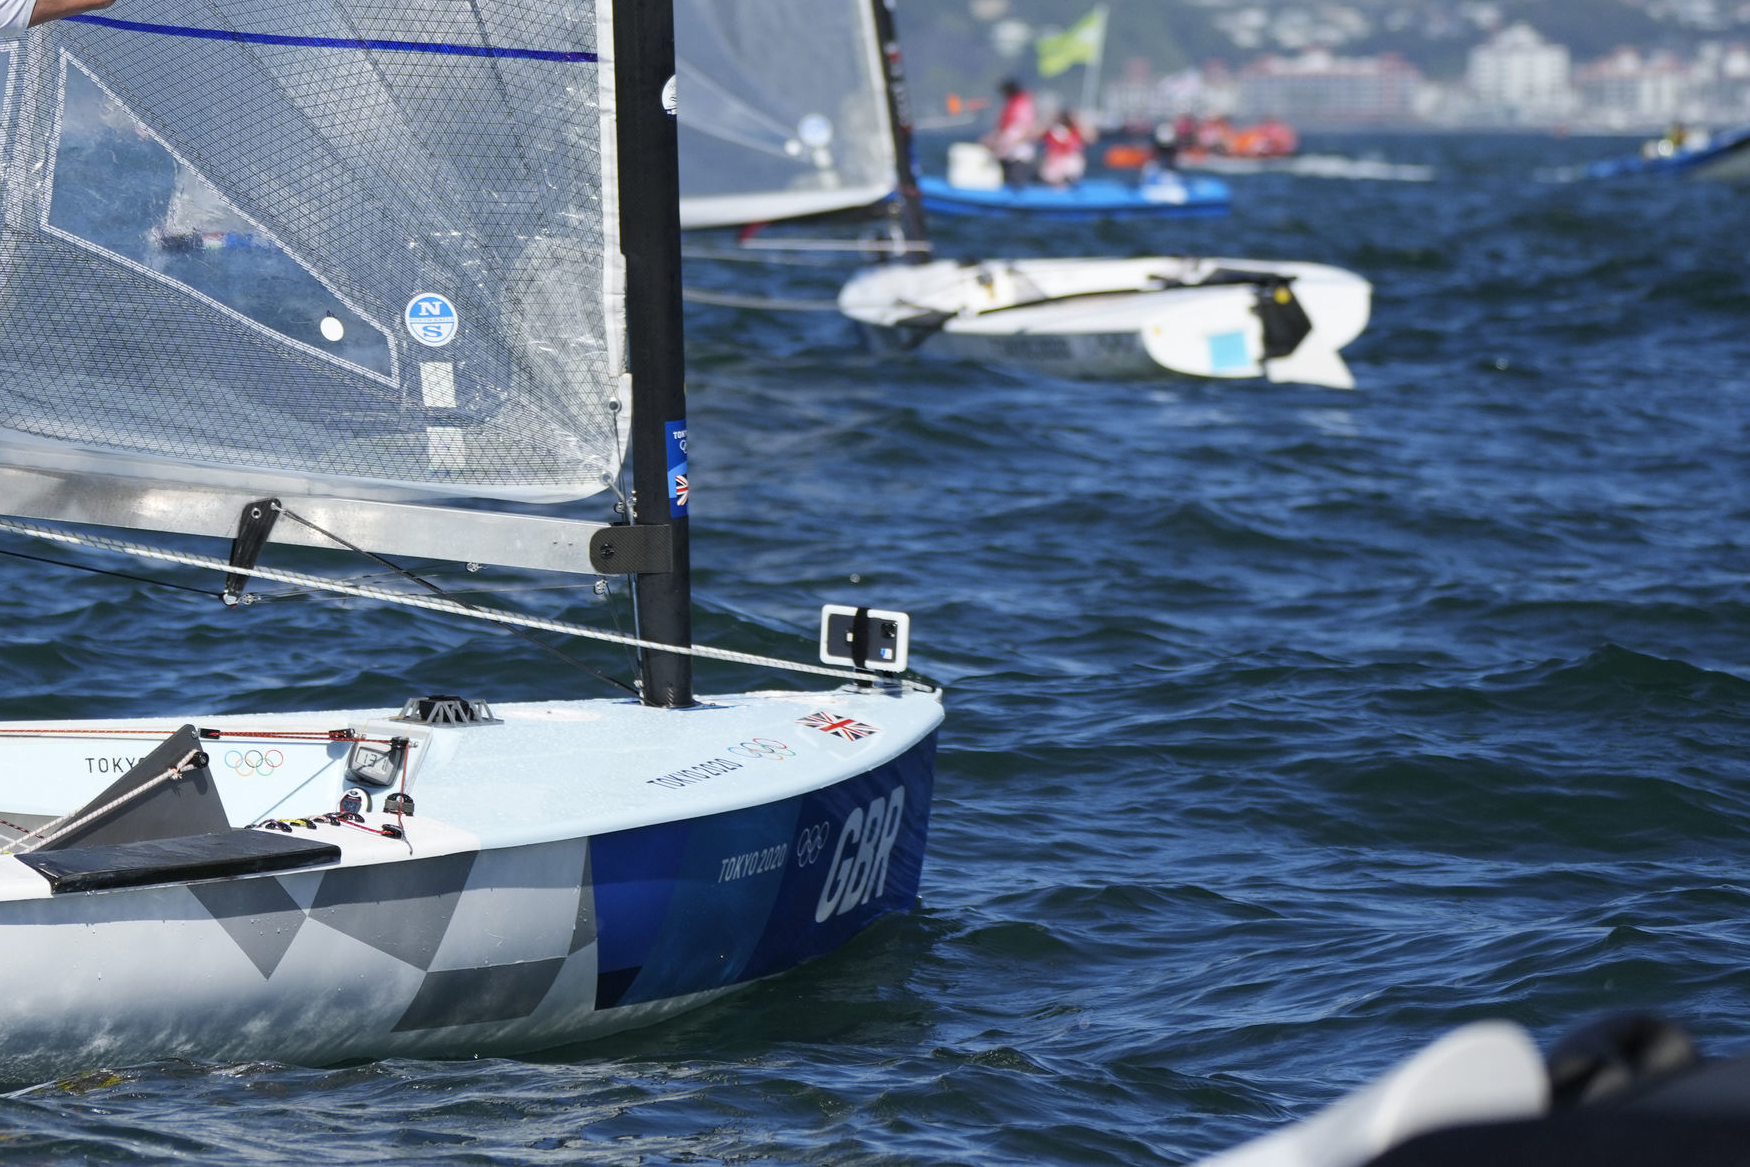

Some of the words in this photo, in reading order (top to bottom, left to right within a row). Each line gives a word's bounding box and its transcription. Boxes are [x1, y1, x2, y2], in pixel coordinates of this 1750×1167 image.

[417, 301, 443, 316] N
[422, 325, 443, 338] S
[85, 757, 146, 773] TOKY
[646, 770, 711, 789] TOKYO
[691, 758, 744, 776] 2020
[718, 851, 759, 884] TOKYO
[756, 842, 788, 874] 2020
[815, 785, 905, 923] GBR
